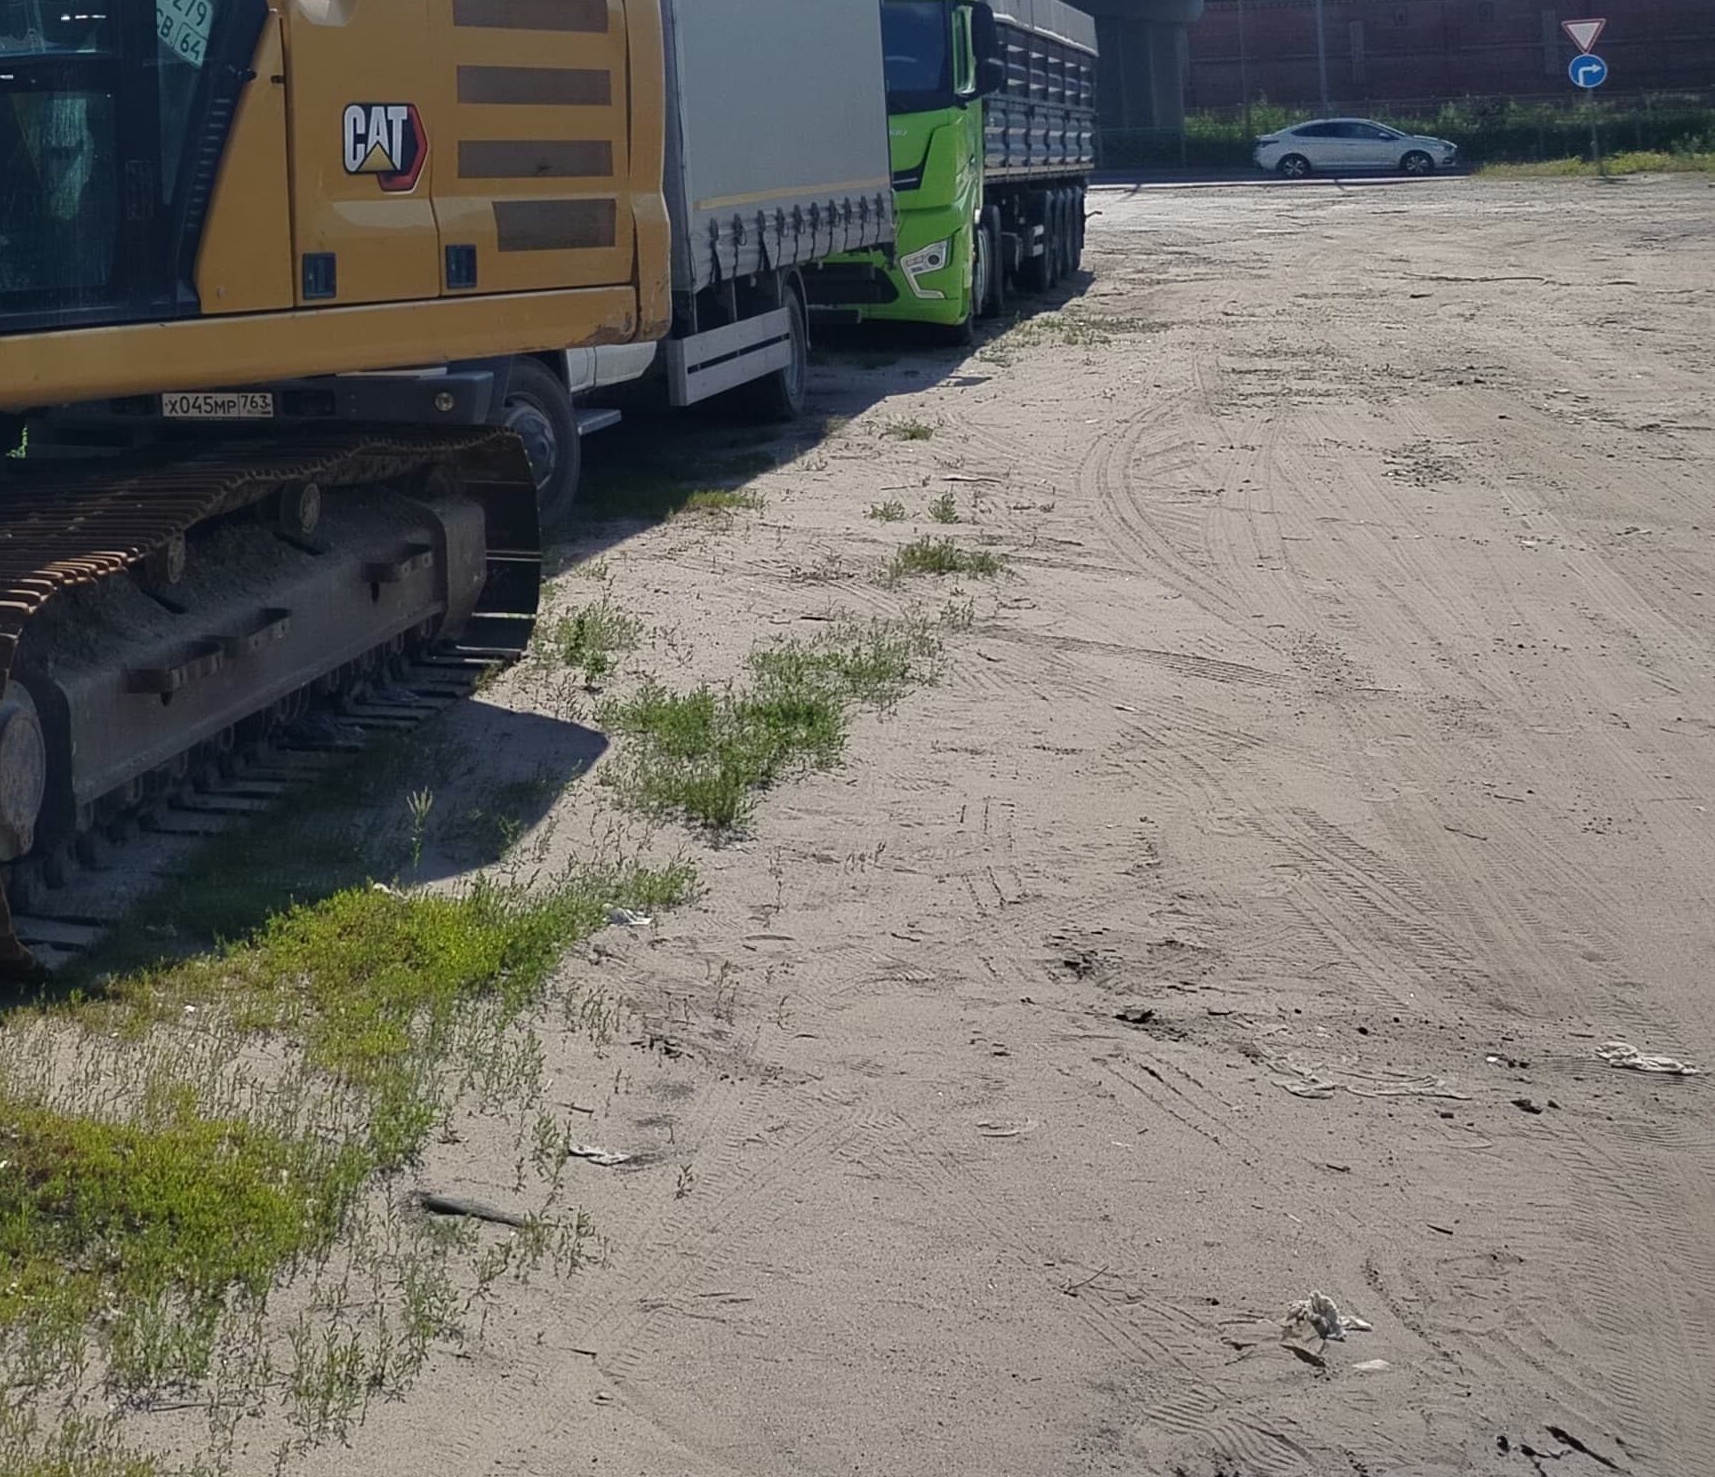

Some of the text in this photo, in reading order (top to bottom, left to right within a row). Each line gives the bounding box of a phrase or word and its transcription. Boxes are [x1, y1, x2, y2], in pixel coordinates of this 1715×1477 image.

[180, 33, 200, 61] 64
[344, 105, 408, 172] CAT
[241, 395, 268, 410] 763
